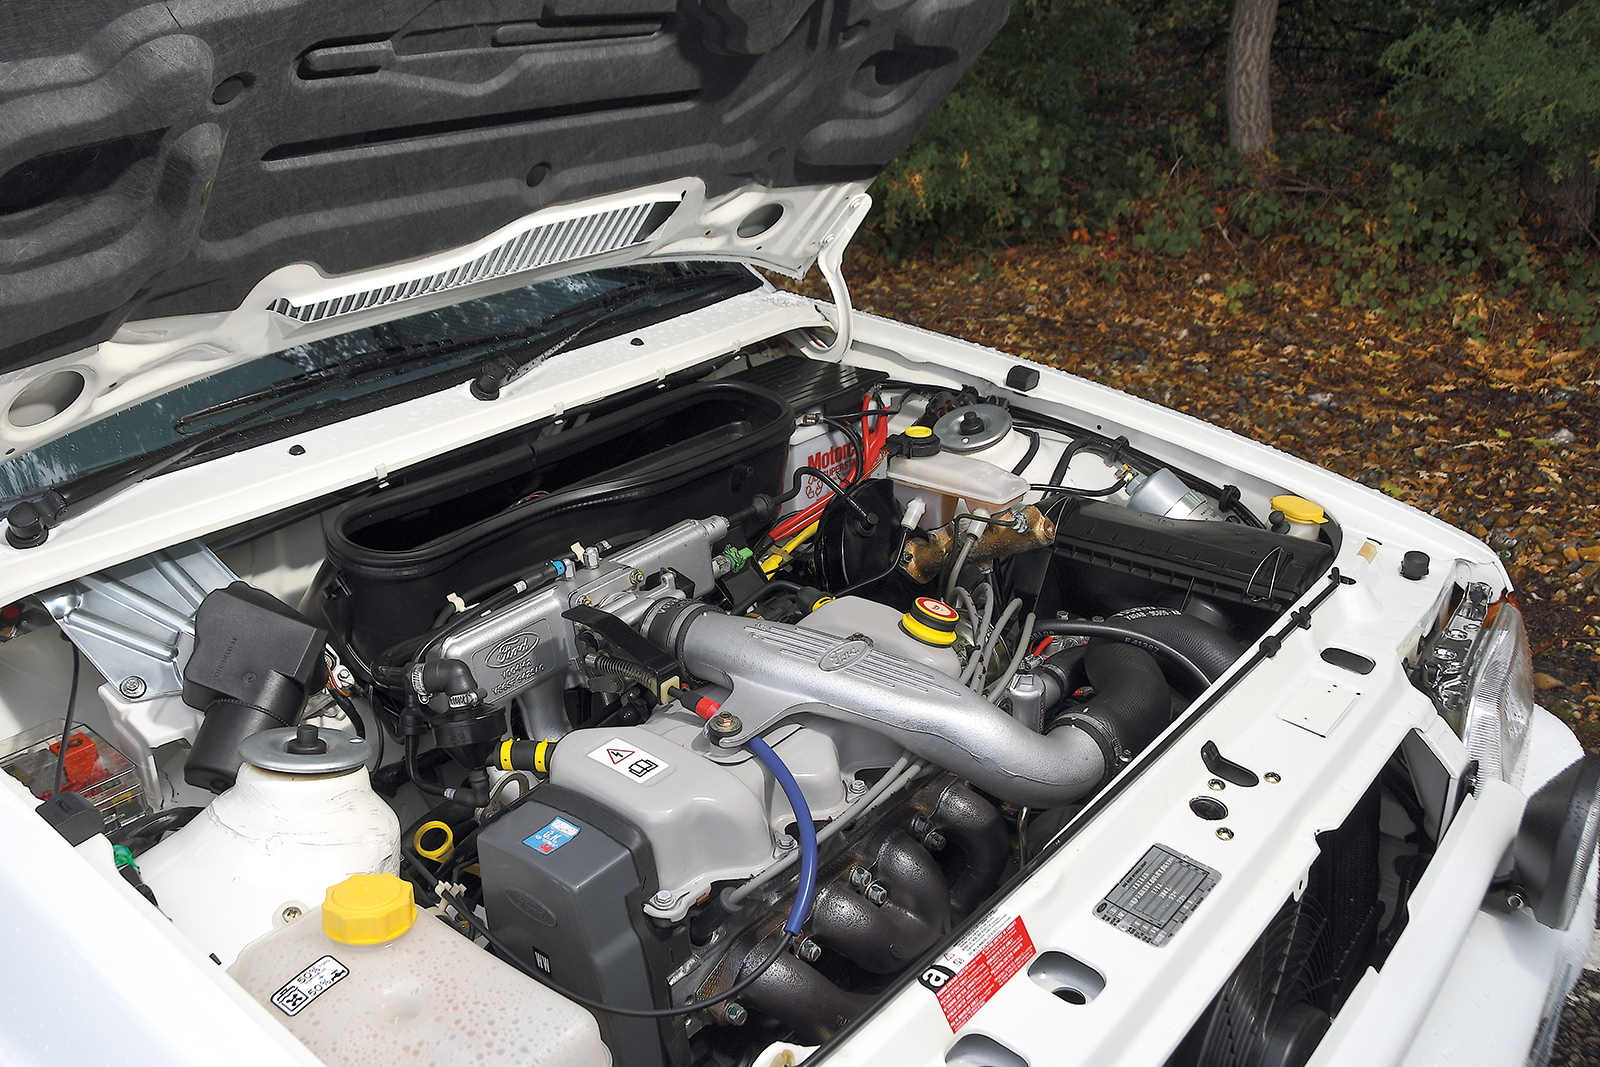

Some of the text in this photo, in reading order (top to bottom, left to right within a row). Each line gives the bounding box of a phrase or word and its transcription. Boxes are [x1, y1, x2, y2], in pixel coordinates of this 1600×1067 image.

[497, 637, 529, 663] Ford
[297, 966, 321, 985] 50%
[920, 968, 951, 987] a
[307, 978, 332, 997] 50%
